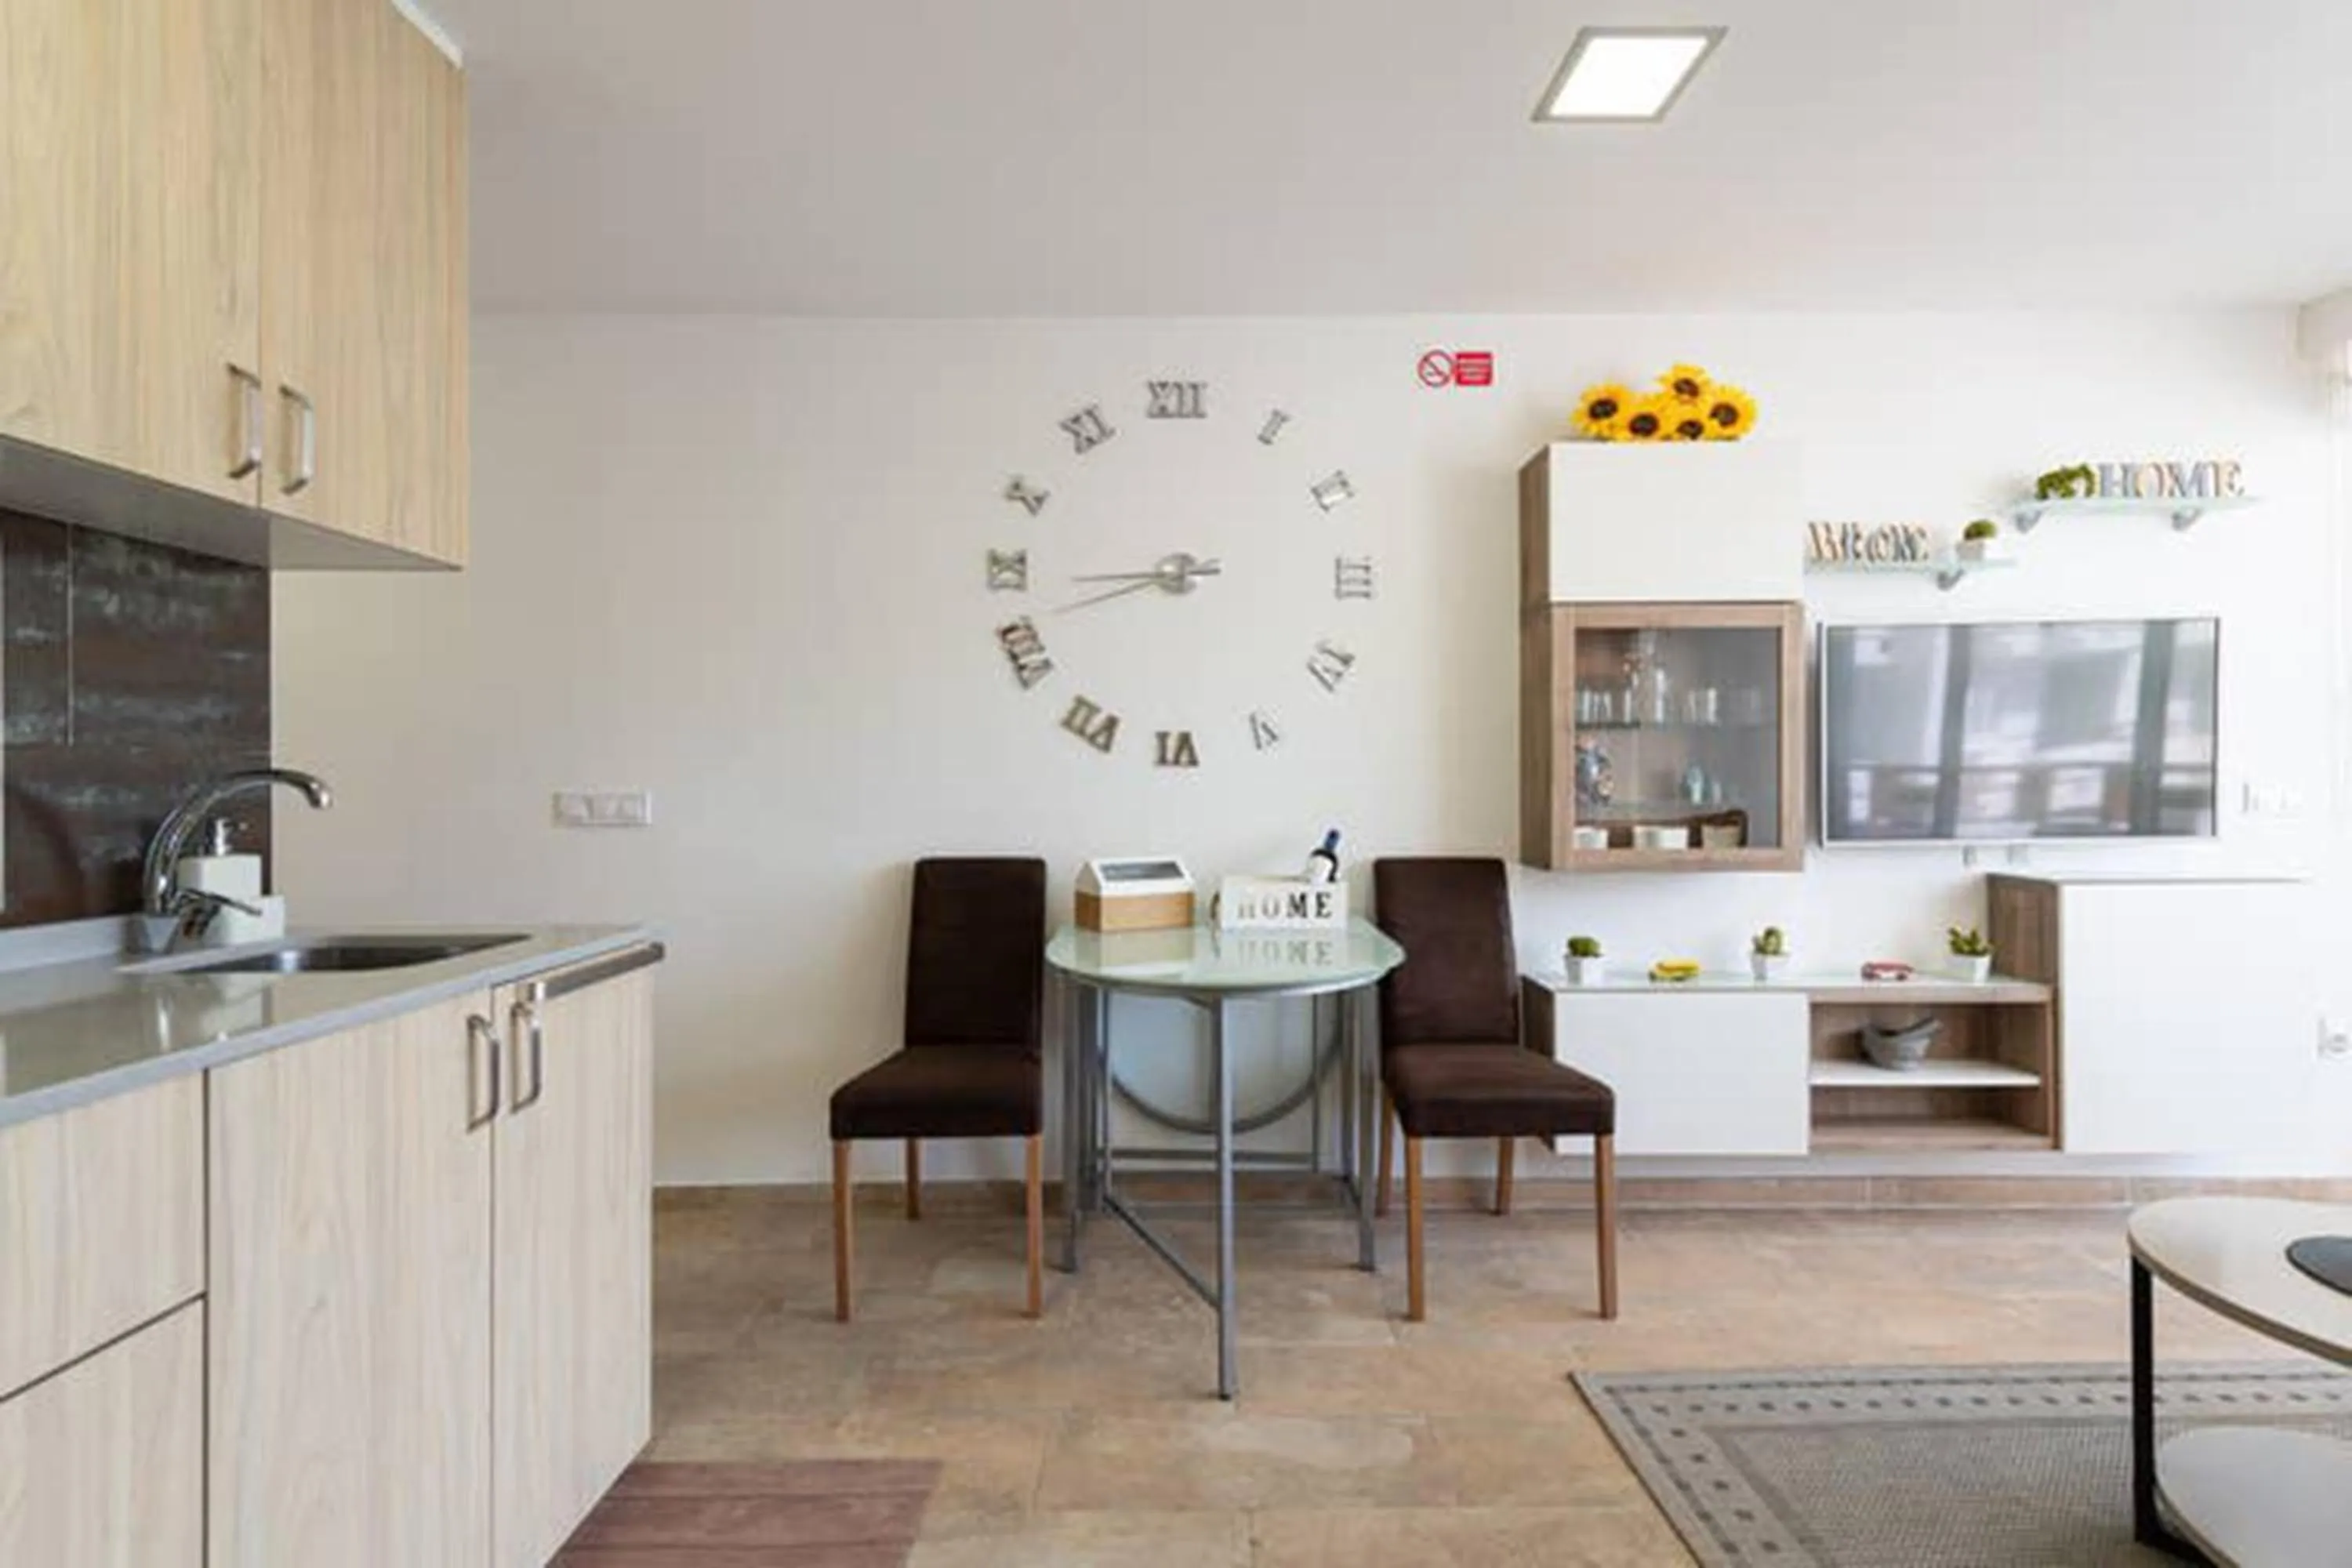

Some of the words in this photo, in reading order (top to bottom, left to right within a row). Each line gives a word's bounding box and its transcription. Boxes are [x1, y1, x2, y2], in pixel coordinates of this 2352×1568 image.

[1146, 380, 1207, 419] XII
[1058, 403, 1116, 455] XI
[2098, 459, 2245, 498] HOME
[1153, 729, 1200, 768] VI
